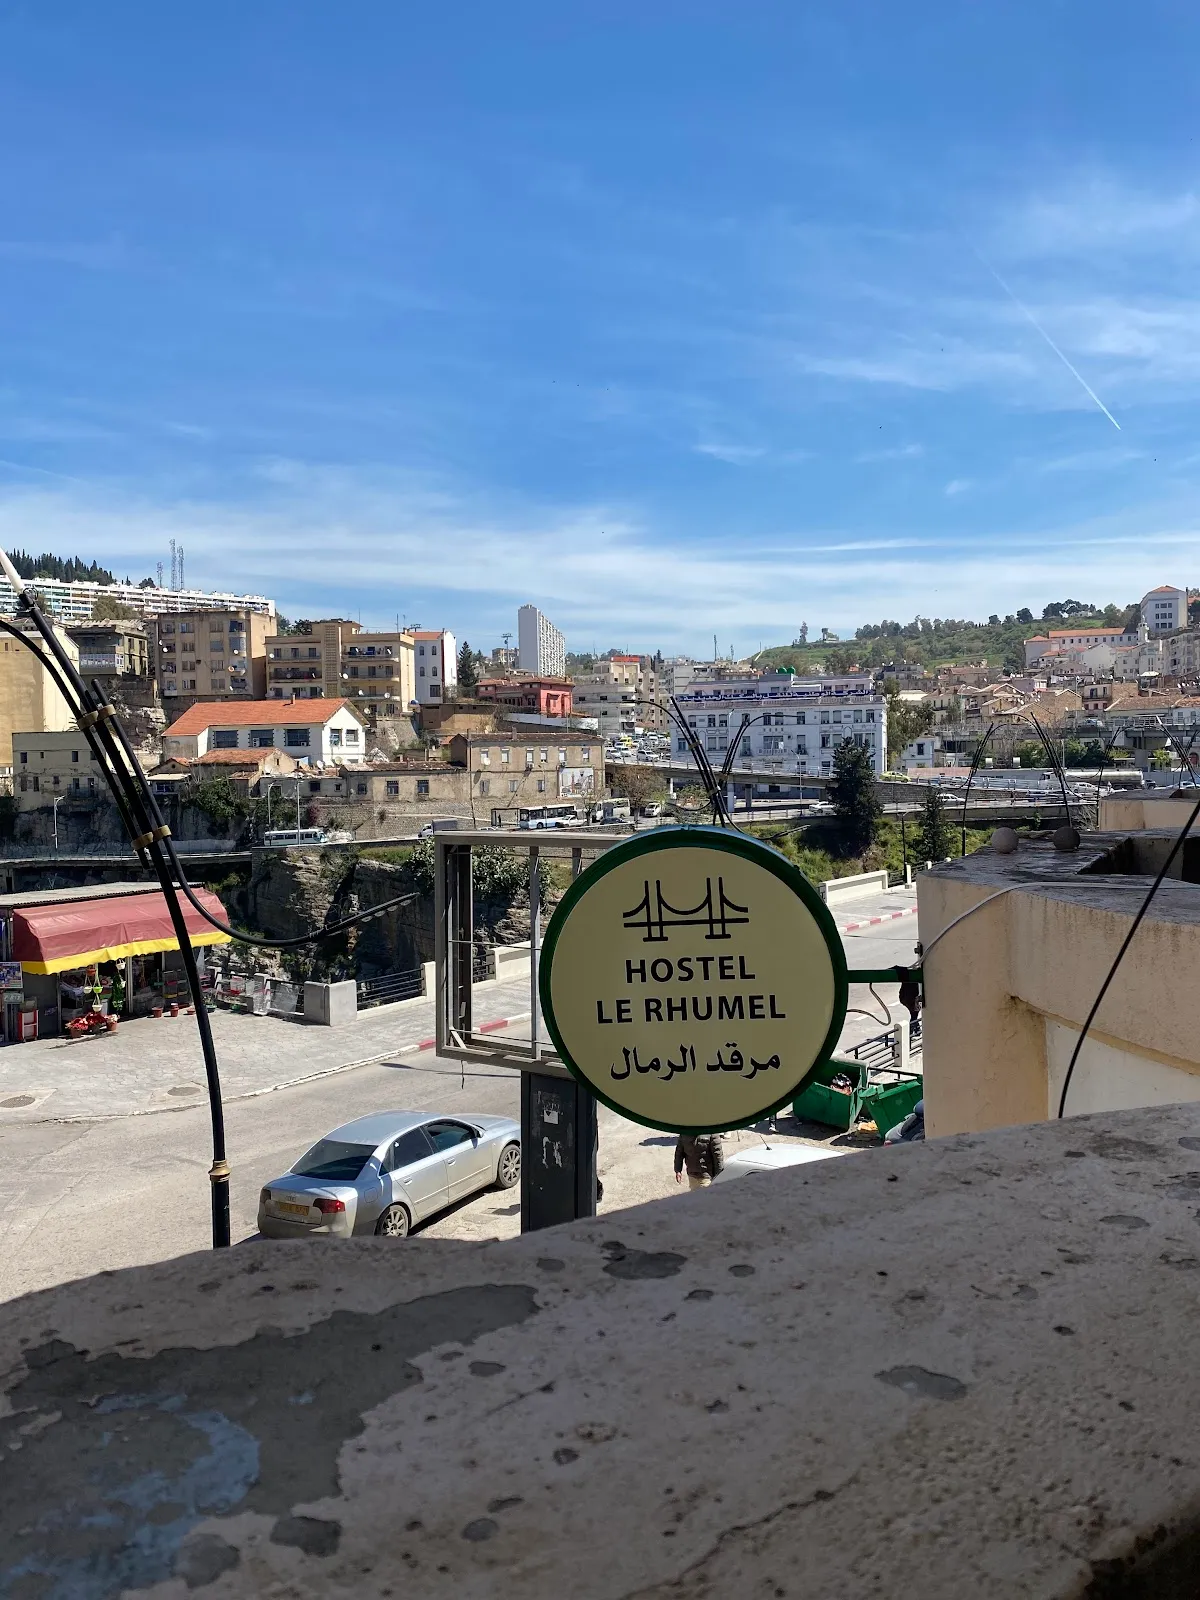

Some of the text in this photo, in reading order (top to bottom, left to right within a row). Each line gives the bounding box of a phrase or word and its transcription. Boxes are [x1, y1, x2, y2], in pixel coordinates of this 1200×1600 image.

[626, 956, 755, 983] HOSTEL
[597, 994, 786, 1025] LE RHUMEL
[610, 1042, 781, 1081] مرقد الرمال
